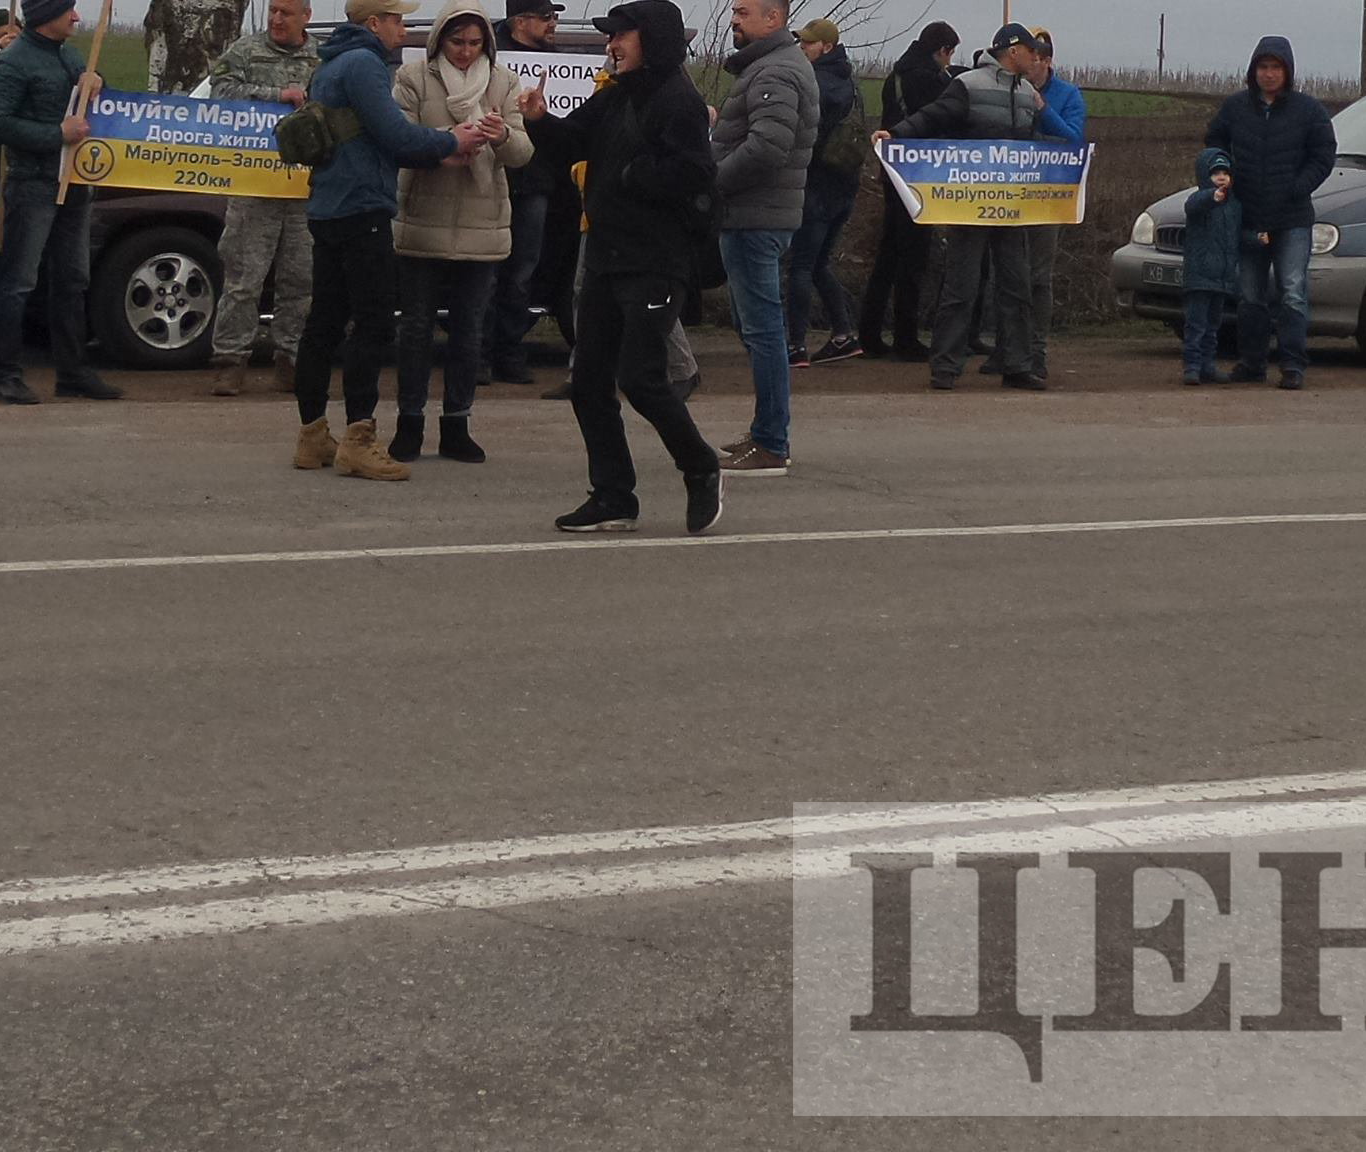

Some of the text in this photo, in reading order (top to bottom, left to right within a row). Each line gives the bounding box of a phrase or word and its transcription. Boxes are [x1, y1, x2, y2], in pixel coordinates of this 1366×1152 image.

[549, 95, 589, 110] КОП
[146, 124, 269, 149] Дорога життя
[887, 144, 1084, 169] Почуйте Маріуполь!
[173, 170, 231, 188] 220км
[947, 167, 1041, 184] Дорога життя
[977, 206, 1020, 220] 220км
